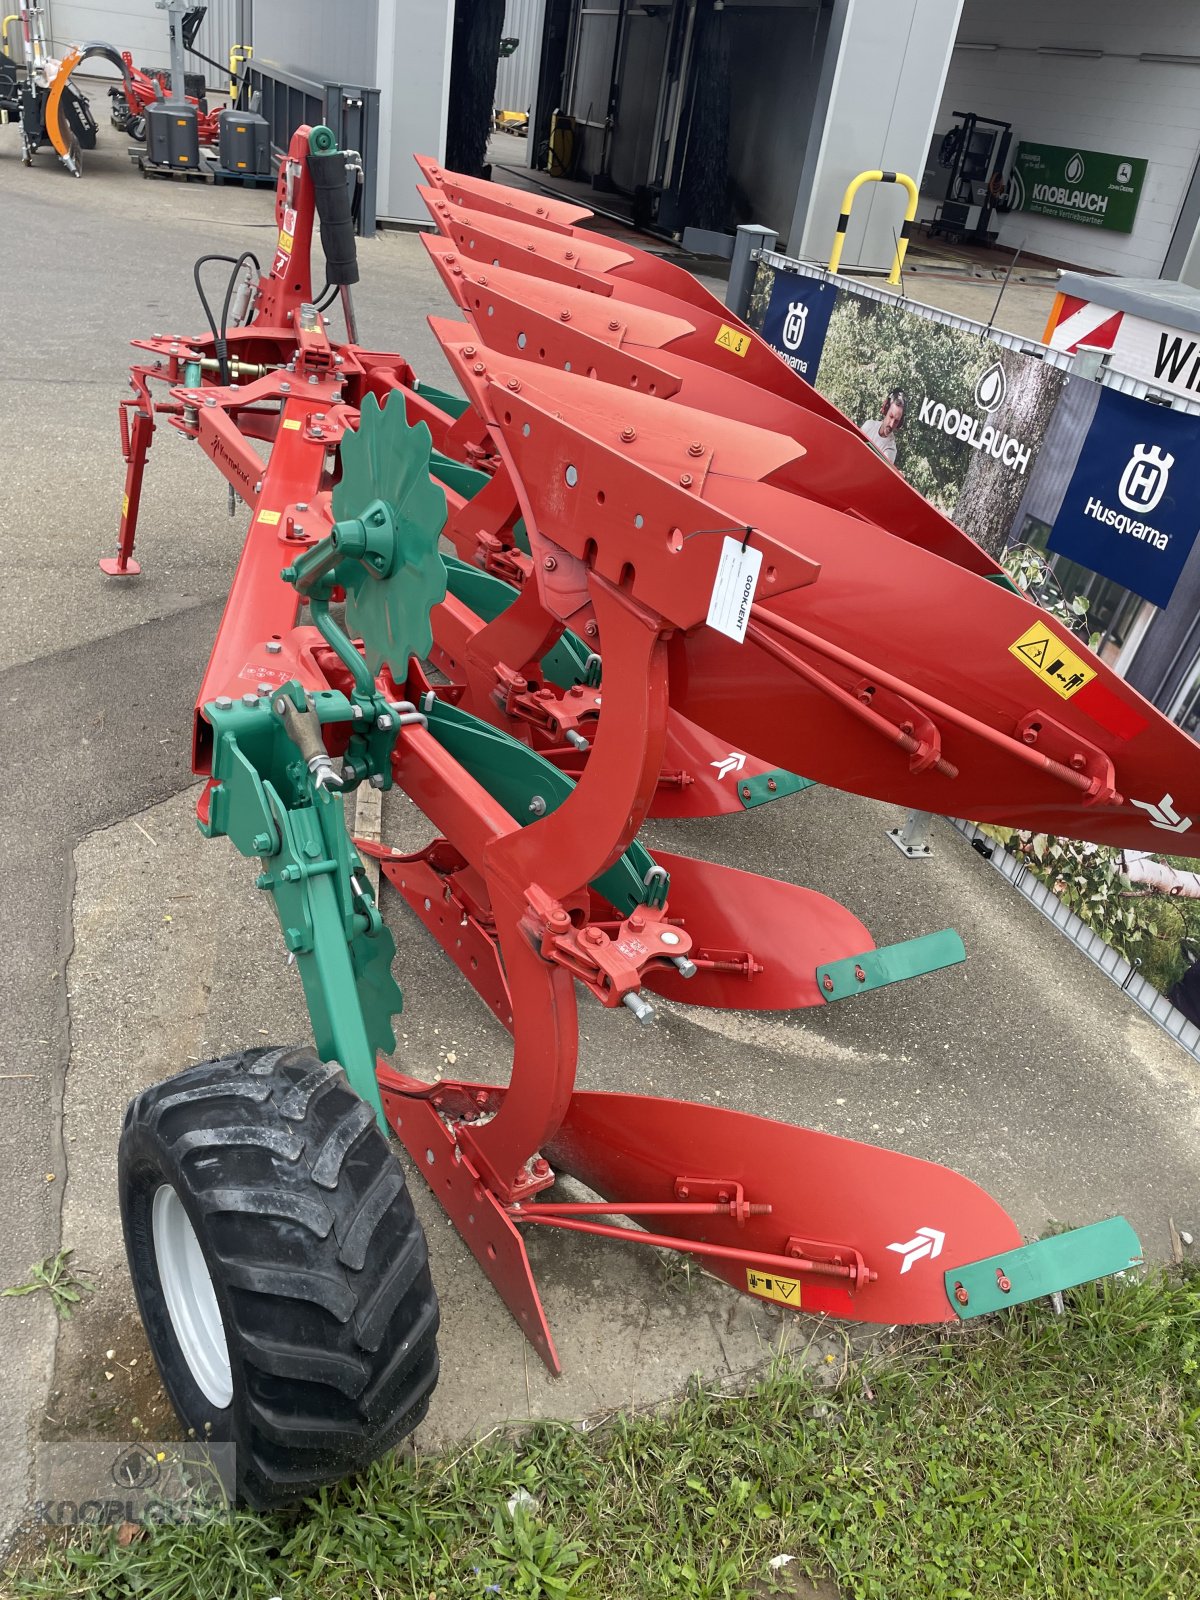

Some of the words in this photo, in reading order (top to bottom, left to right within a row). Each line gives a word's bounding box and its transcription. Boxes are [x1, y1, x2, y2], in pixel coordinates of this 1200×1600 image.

[1032, 183, 1108, 212] KNOBLAUCH
[1042, 206, 1058, 216] Deere
[1059, 209, 1104, 225] Vertriebspartner
[919, 397, 1031, 475] KNOBLAUCH
[1084, 496, 1169, 551] Husqvarna
[736, 575, 753, 630] GODKJENT
